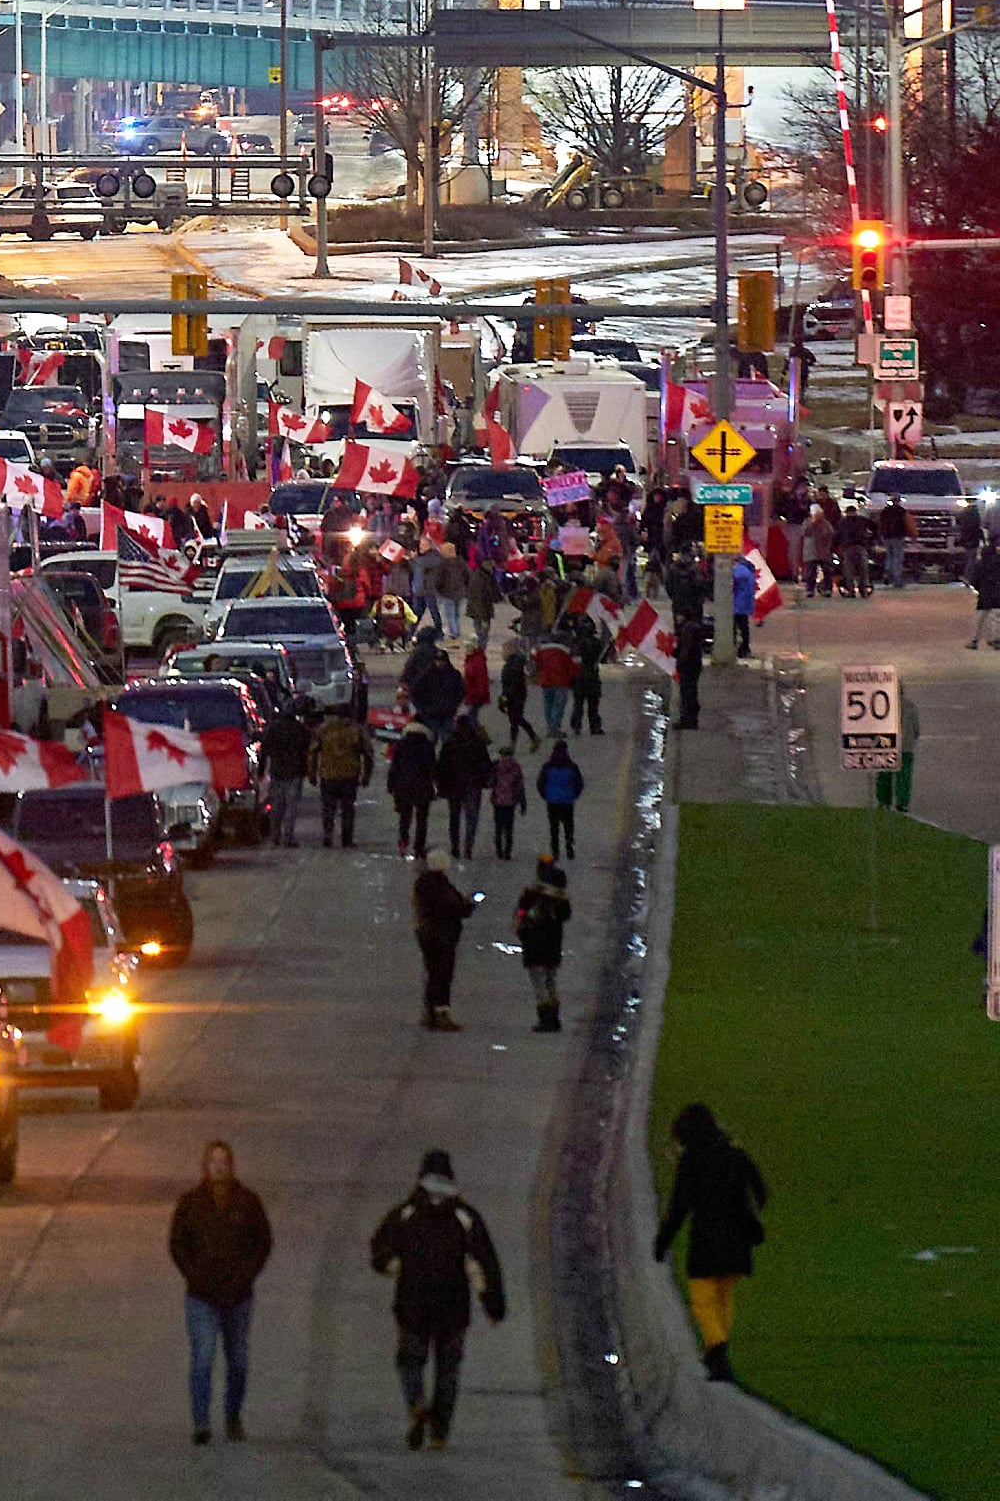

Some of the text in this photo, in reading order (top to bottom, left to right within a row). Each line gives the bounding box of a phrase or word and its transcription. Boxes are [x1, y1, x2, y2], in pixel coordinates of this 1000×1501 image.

[695, 487, 740, 501] College
[847, 690, 891, 721] 50
[842, 752, 898, 771] BEGINS
